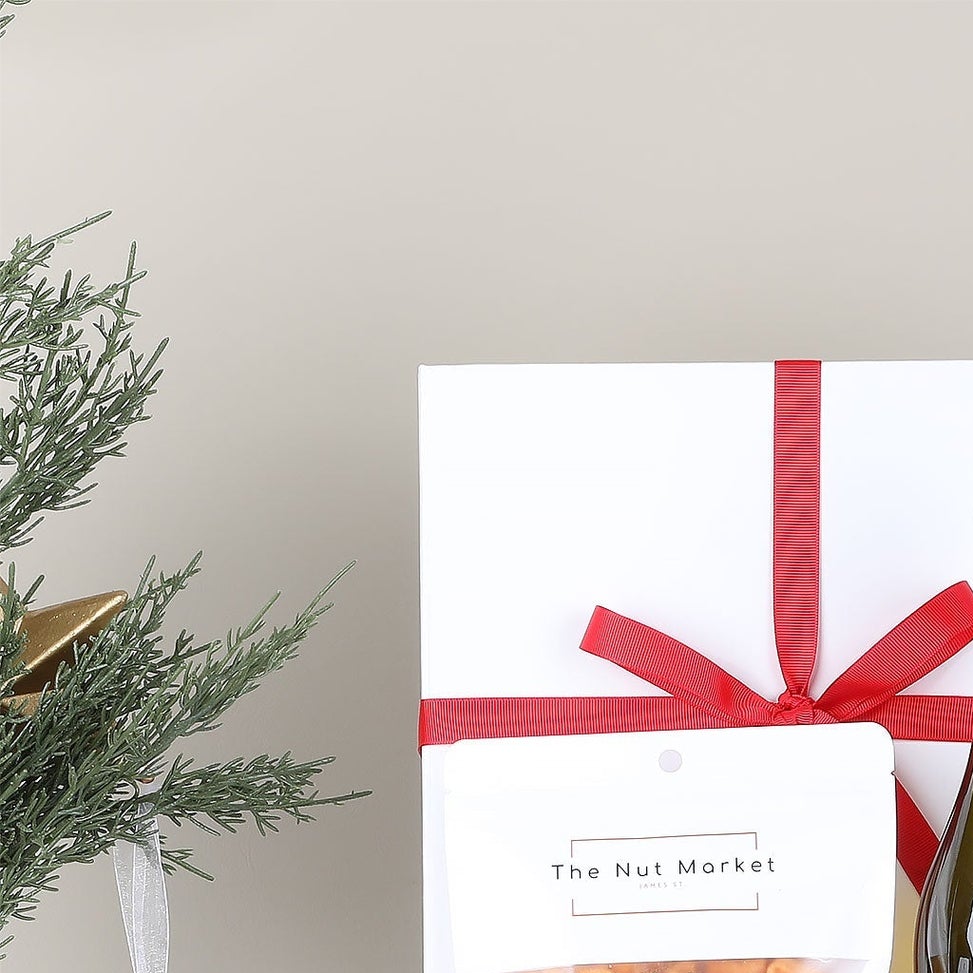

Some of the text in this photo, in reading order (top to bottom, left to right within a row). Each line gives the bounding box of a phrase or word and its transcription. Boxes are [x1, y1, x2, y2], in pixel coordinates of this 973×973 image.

[552, 858, 775, 880] The Nut Market
